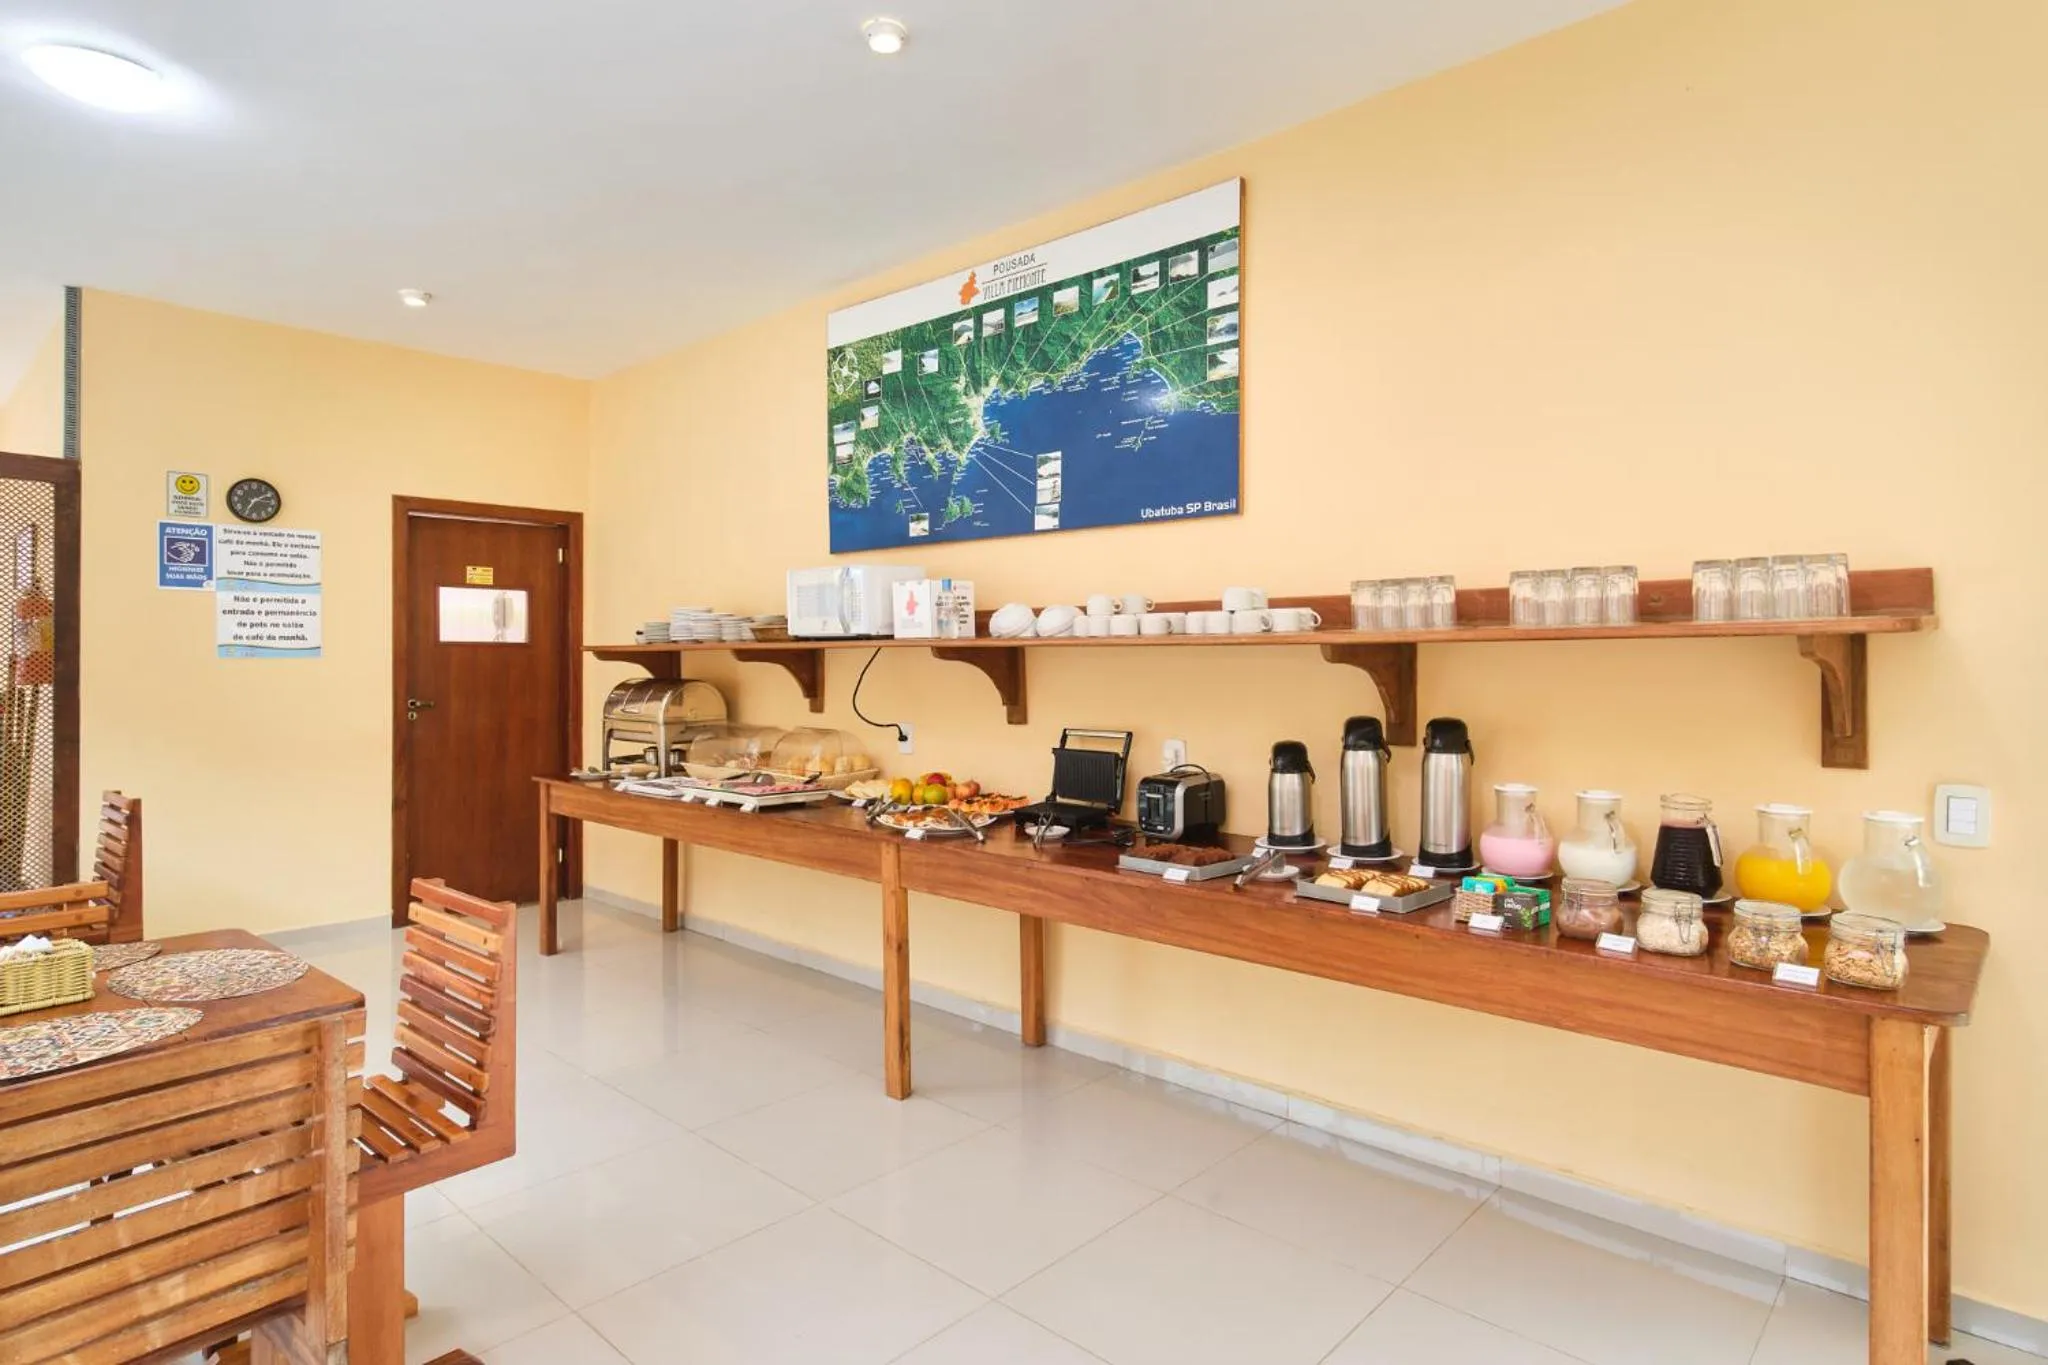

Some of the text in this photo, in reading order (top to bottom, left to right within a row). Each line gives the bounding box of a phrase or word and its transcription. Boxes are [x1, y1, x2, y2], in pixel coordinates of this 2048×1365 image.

[994, 253, 1036, 275] POUSADA
[1140, 498, 1237, 519] Ubatuba SP Brasil
[165, 527, 207, 537] ATENÇÃO
[233, 595, 251, 603] Não
[222, 608, 255, 616] entrada
[249, 621, 268, 629] pets
[245, 633, 265, 641] café
